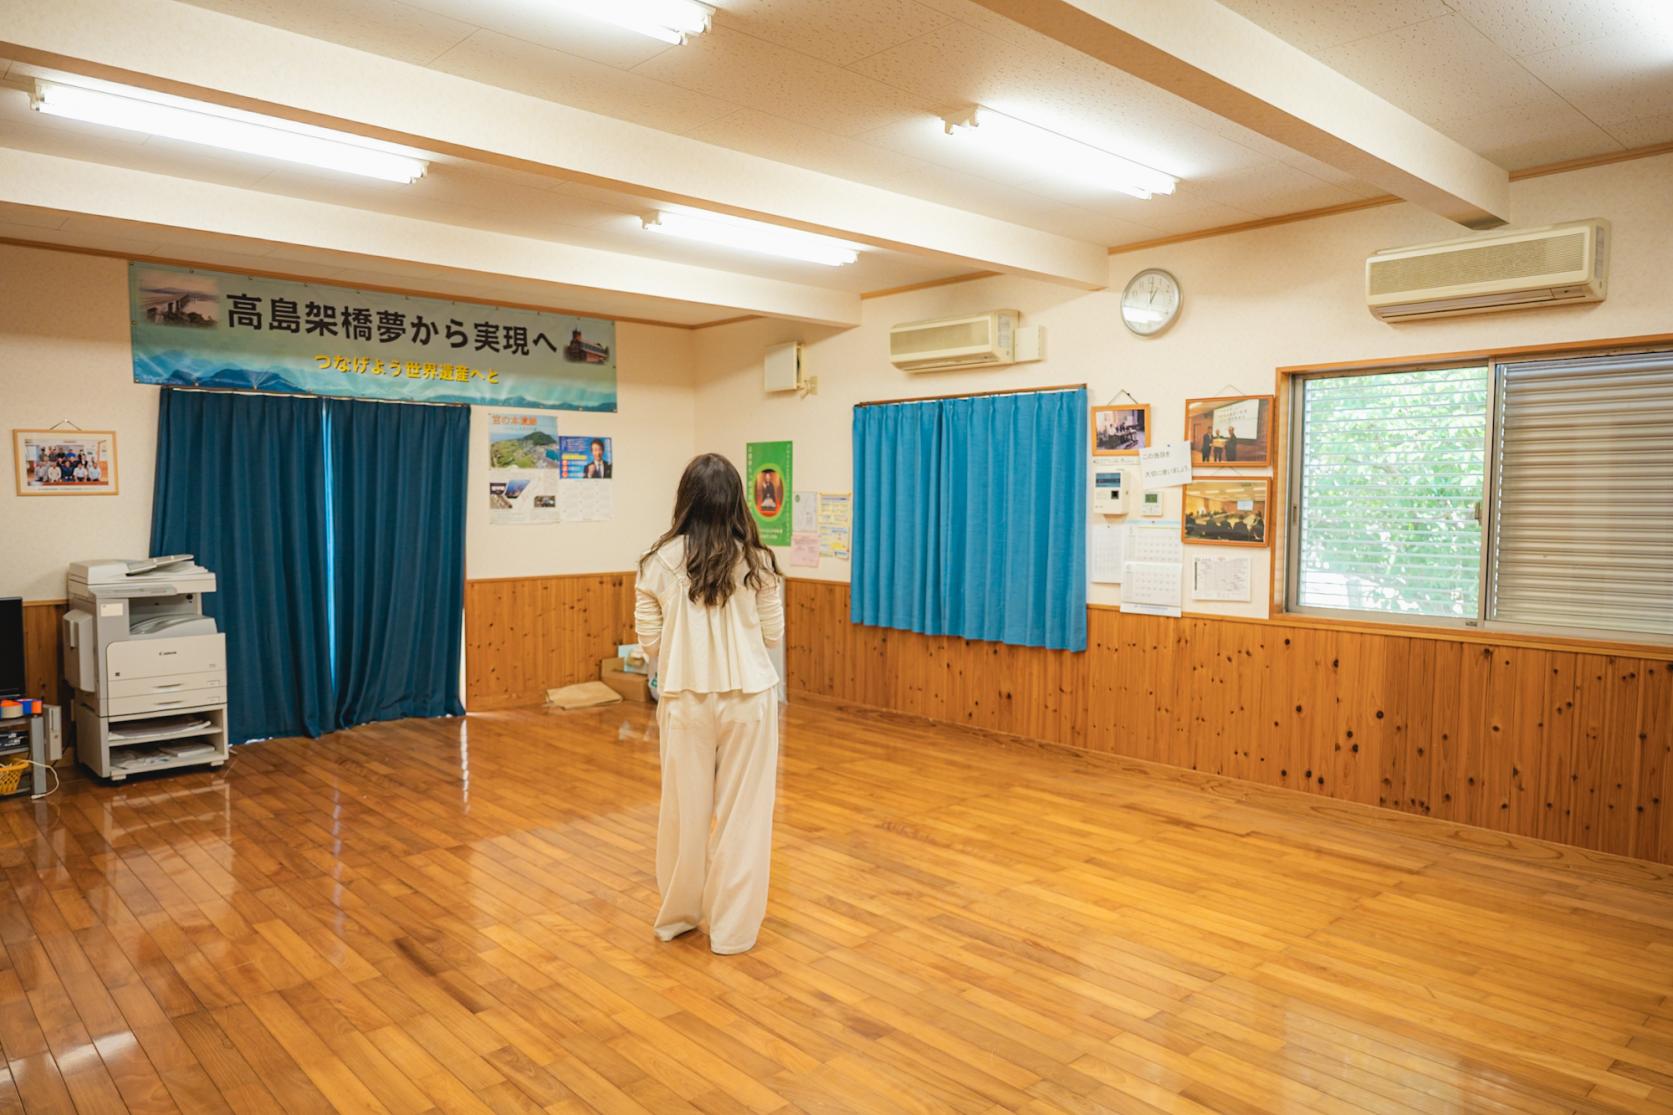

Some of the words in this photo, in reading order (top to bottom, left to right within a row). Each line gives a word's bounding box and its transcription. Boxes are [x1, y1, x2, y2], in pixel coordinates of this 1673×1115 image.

[226, 293, 557, 356] 高島架橋夢から実現へ
[314, 353, 499, 384] つなげよう世界遺産へと
